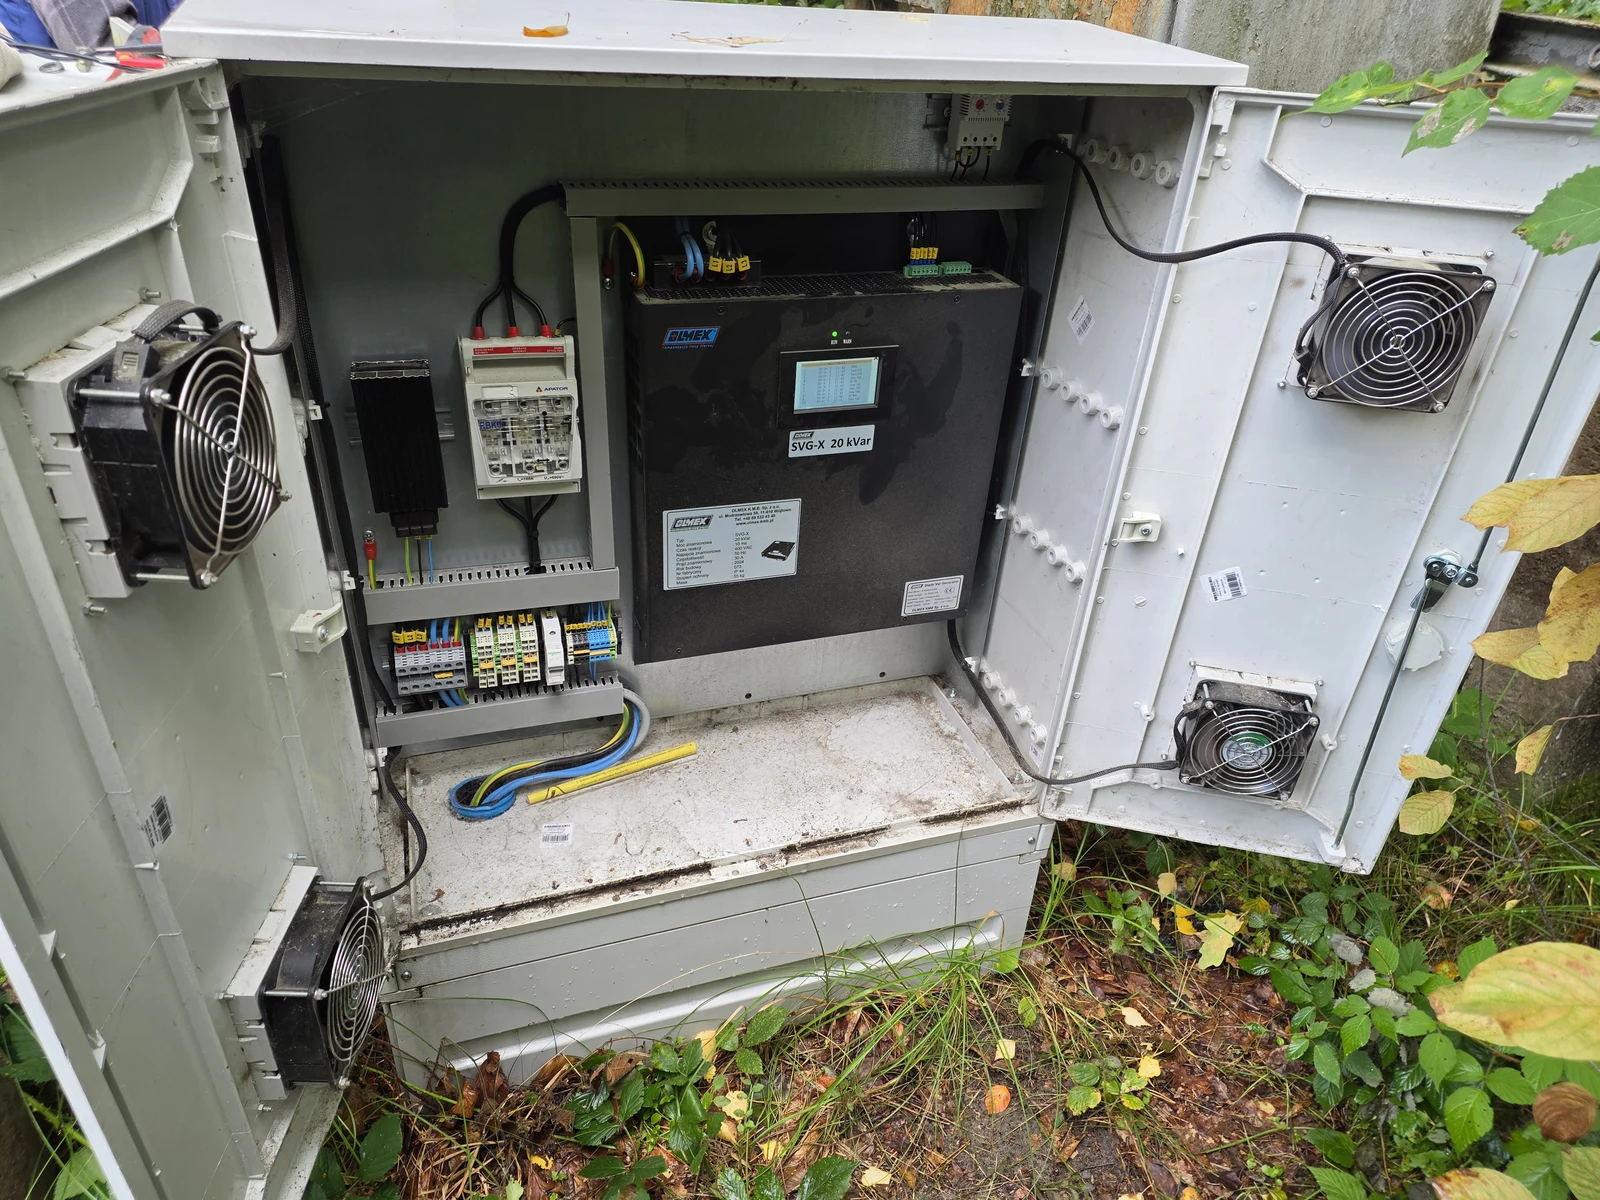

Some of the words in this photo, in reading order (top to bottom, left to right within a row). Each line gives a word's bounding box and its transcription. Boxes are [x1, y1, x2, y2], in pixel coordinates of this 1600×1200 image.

[668, 329, 712, 342] OLMEX
[791, 440, 825, 451] SVG-X
[831, 439, 844, 448] 20
[847, 437, 871, 447] kVar
[675, 518, 708, 528] OLMEX
